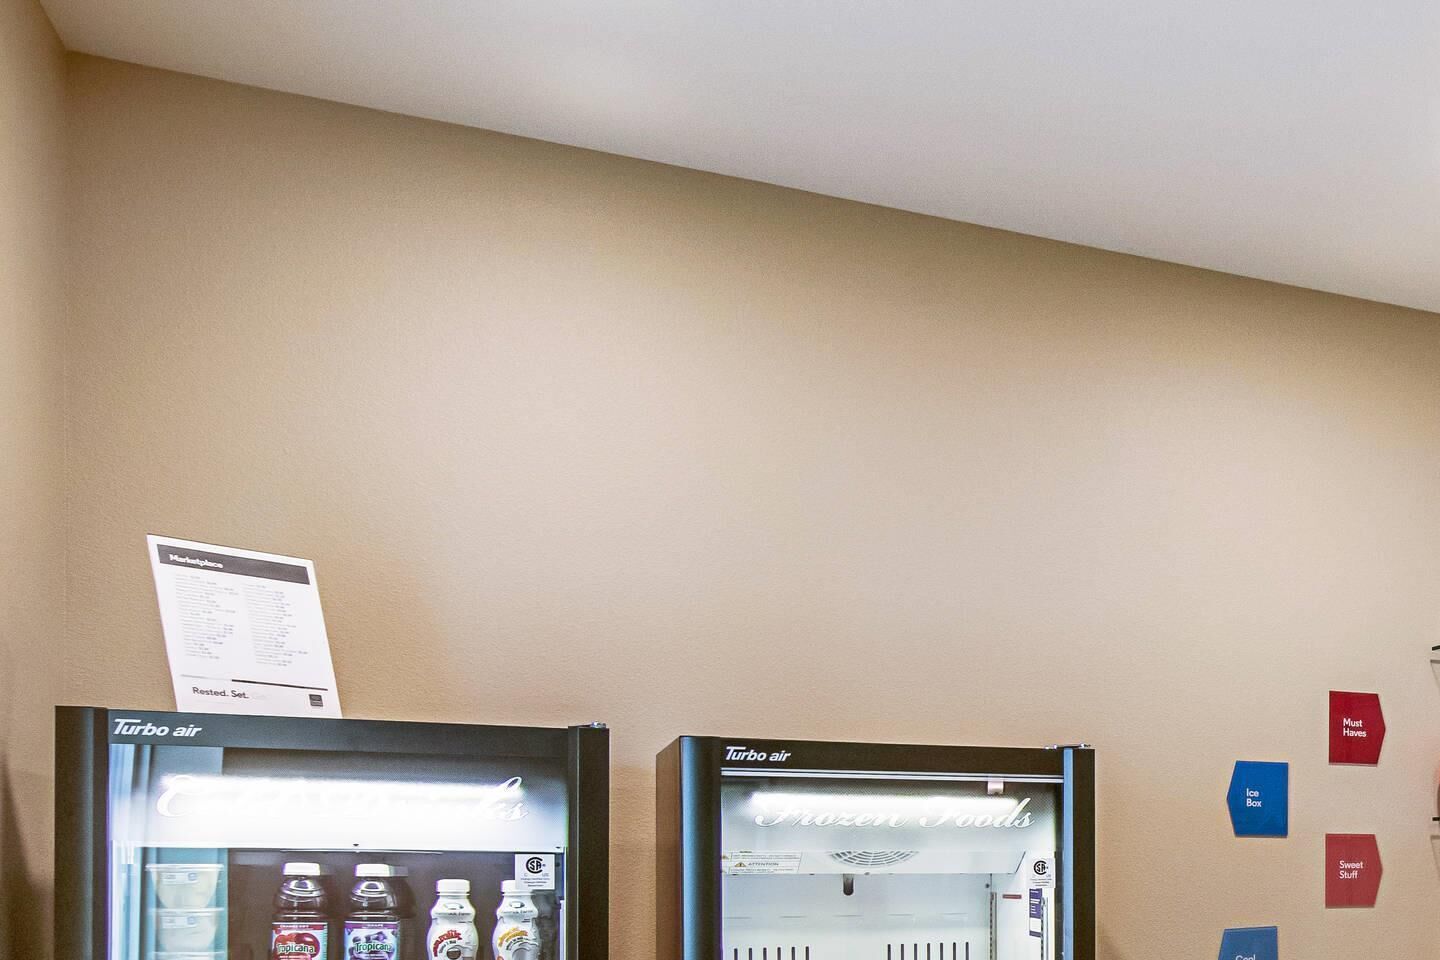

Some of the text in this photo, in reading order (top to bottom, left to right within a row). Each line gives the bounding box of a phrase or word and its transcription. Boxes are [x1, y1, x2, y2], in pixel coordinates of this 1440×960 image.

[169, 554, 224, 569] Marketplace
[192, 686, 250, 699] Rested. Set.
[1343, 718, 1363, 727] Must
[112, 718, 202, 737] Turbo air
[1343, 728, 1367, 737] Haves
[725, 746, 791, 762] Turbo air
[1246, 788, 1259, 797] Ice
[1246, 799, 1262, 807] Box
[754, 797, 1036, 828] Frozen Foods
[1339, 861, 1364, 869] Sweet
[1339, 870, 1358, 879] Stuff
